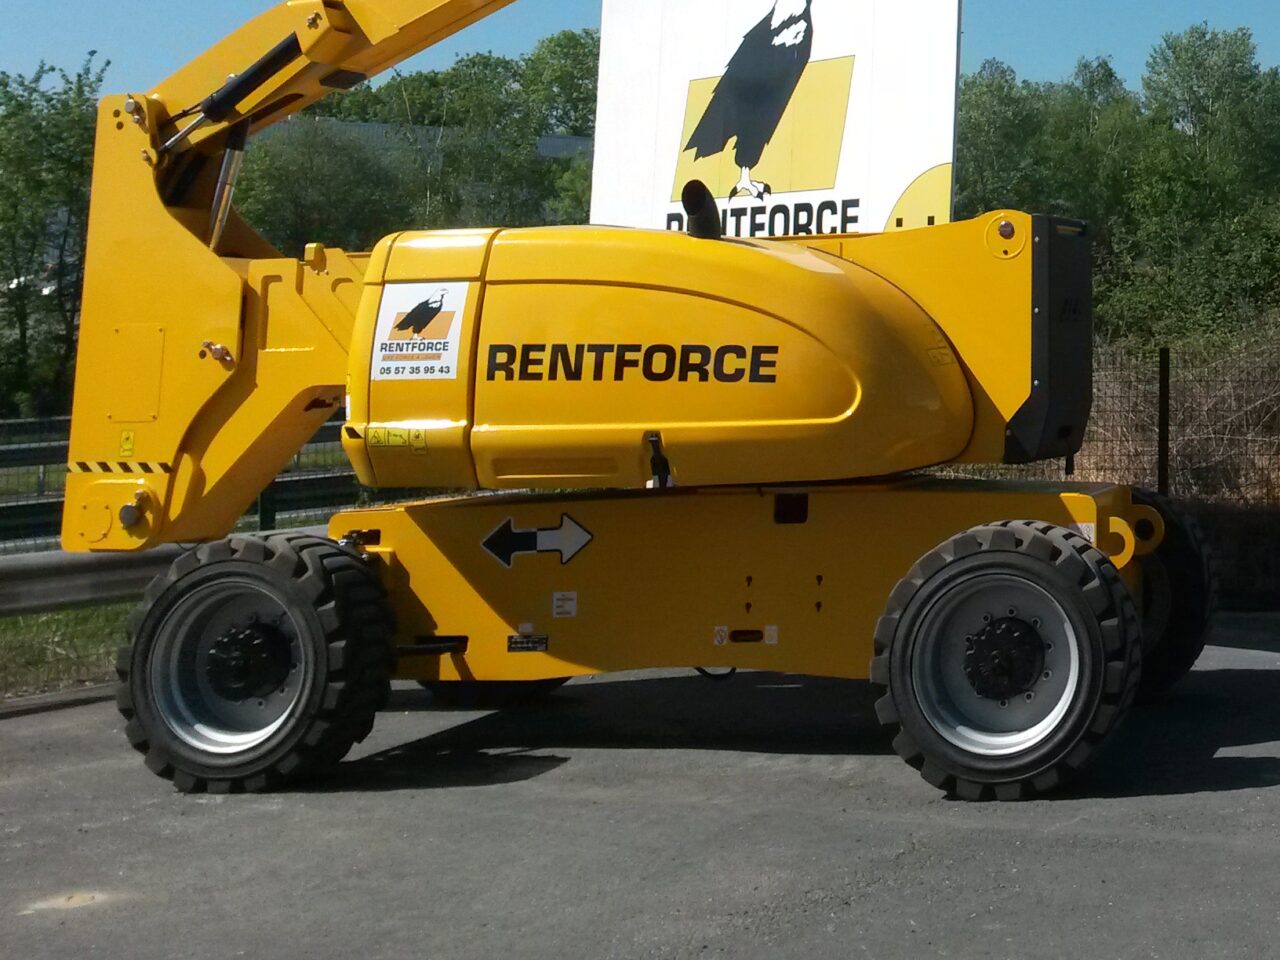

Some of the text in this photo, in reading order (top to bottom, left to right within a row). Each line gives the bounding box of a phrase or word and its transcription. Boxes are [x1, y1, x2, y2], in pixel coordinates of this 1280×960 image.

[380, 341, 449, 352] RENTFORCE
[486, 343, 779, 383] RENTFORCE
[380, 365, 450, 375] 05 57 35 95 43
